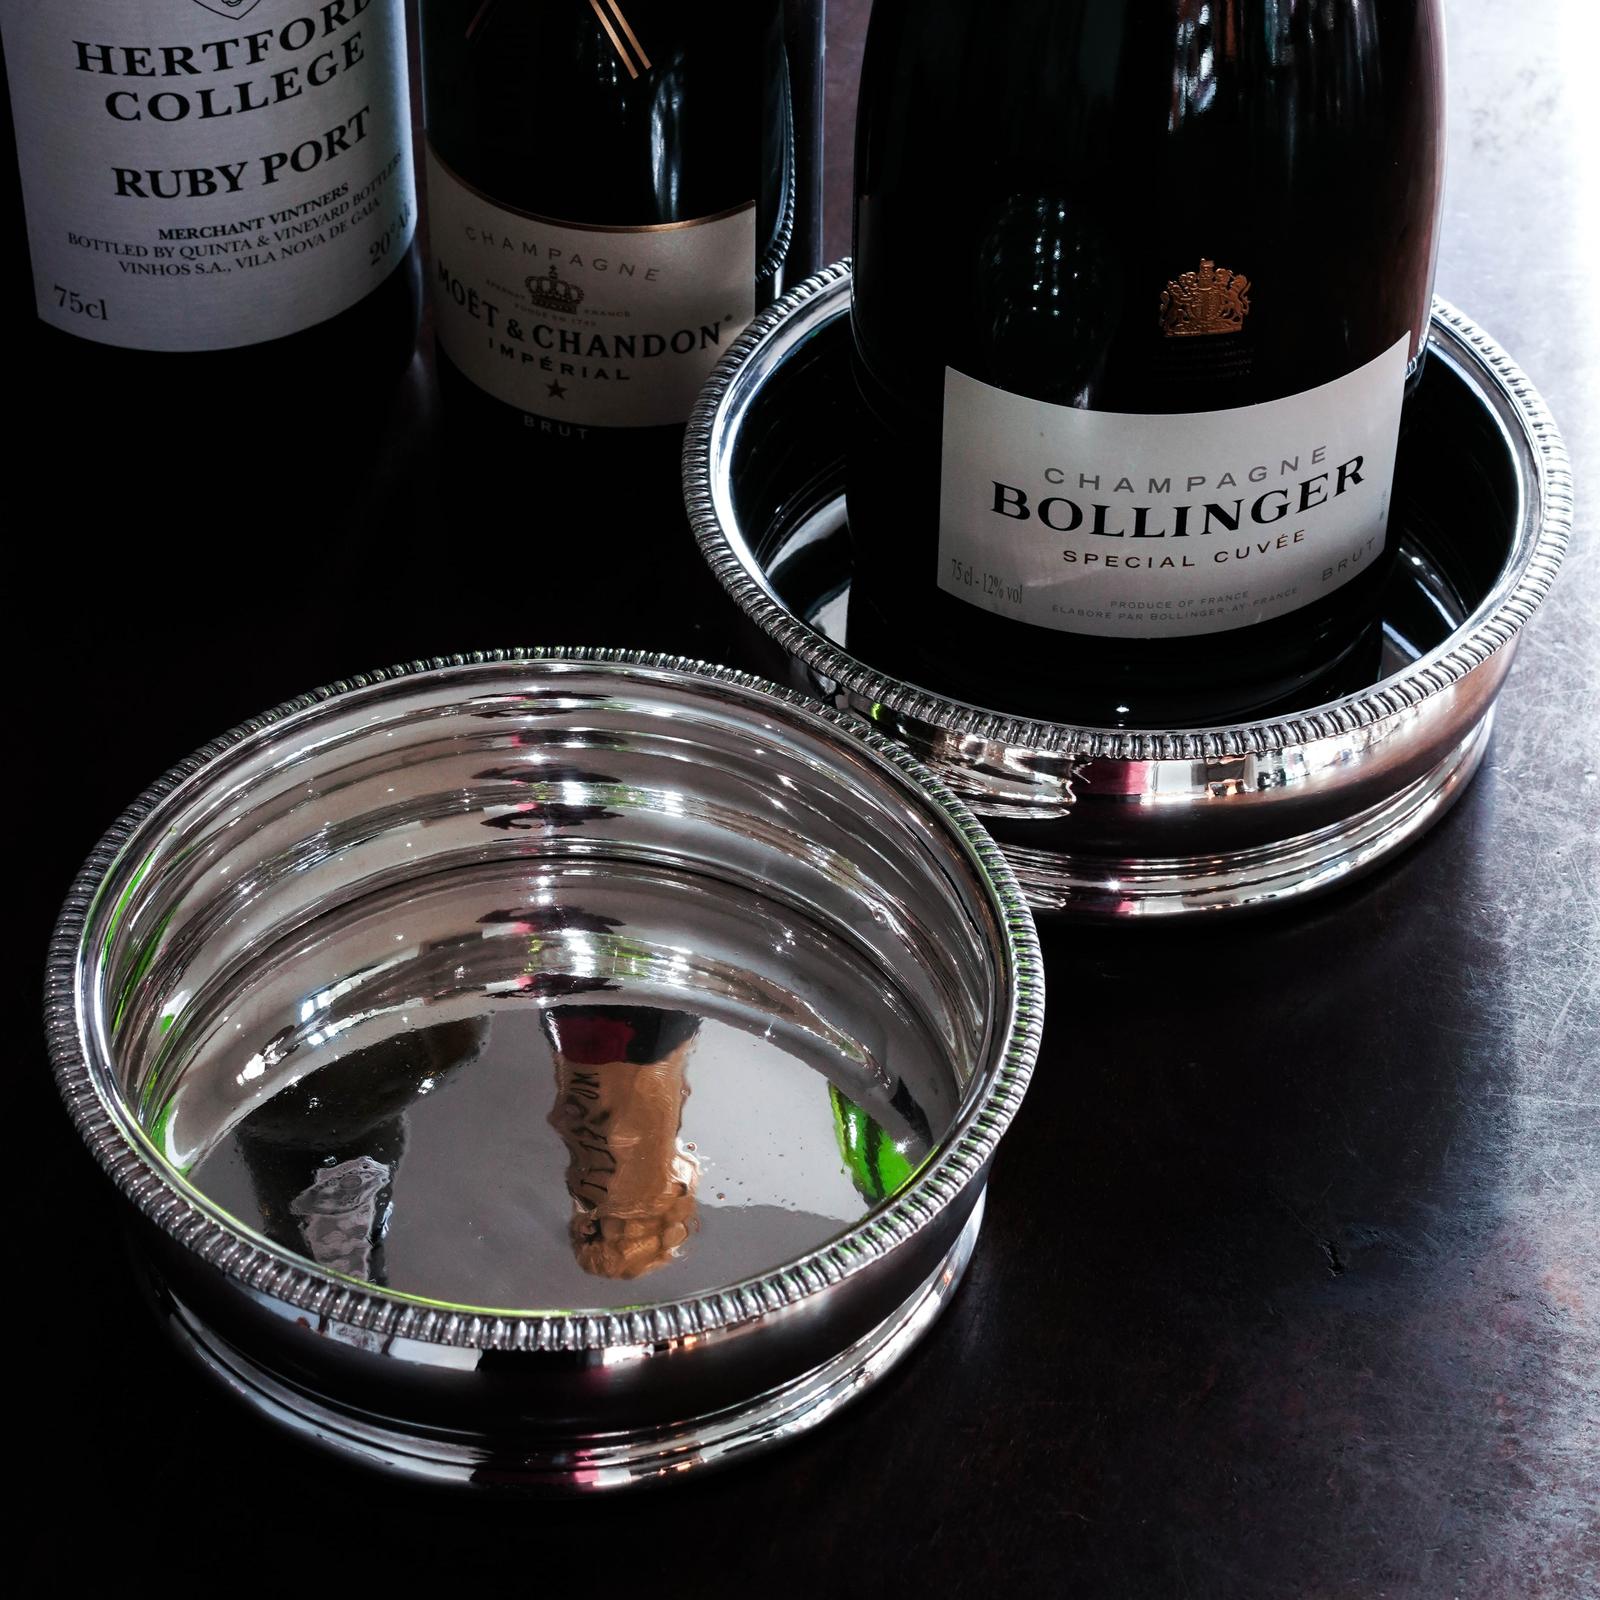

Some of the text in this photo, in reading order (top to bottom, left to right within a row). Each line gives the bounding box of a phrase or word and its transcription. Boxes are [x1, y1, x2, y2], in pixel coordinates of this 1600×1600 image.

[105, 31, 365, 121] COLLEGE
[111, 105, 371, 199] RUBY PORT
[67, 231, 148, 258] BOTTLED
[153, 246, 176, 259] BY
[179, 238, 253, 261] QUINTA
[257, 234, 271, 248] &
[274, 201, 350, 243] VINEYARD
[158, 182, 350, 241] MERCHANT VINTNERS
[119, 260, 191, 277] VINHOS
[235, 250, 278, 270] VILA
[281, 233, 326, 261] NOVA
[329, 221, 347, 240] DE
[351, 196, 382, 226] GAIA
[465, 226, 661, 282] CHAMPAGNE
[53, 284, 109, 320] 75cl
[438, 261, 500, 328] MOËT
[506, 319, 526, 341] &
[488, 337, 631, 380] IMPÉRIAL
[524, 414, 589, 440] BRUT
[1044, 446, 1328, 494] CHAMPAGNE
[990, 455, 1365, 538] BOLLINGER
[1063, 529, 1306, 569] SPECIAL CUVÉE
[1321, 537, 1376, 582] BRUT
[951, 558, 963, 581] 75
[964, 566, 973, 586] cl
[983, 573, 1004, 599] 12%
[1007, 584, 1024, 604] vol
[1110, 591, 1249, 610] PRODUCE OF FRANCE
[1118, 612, 1144, 621] PAR
